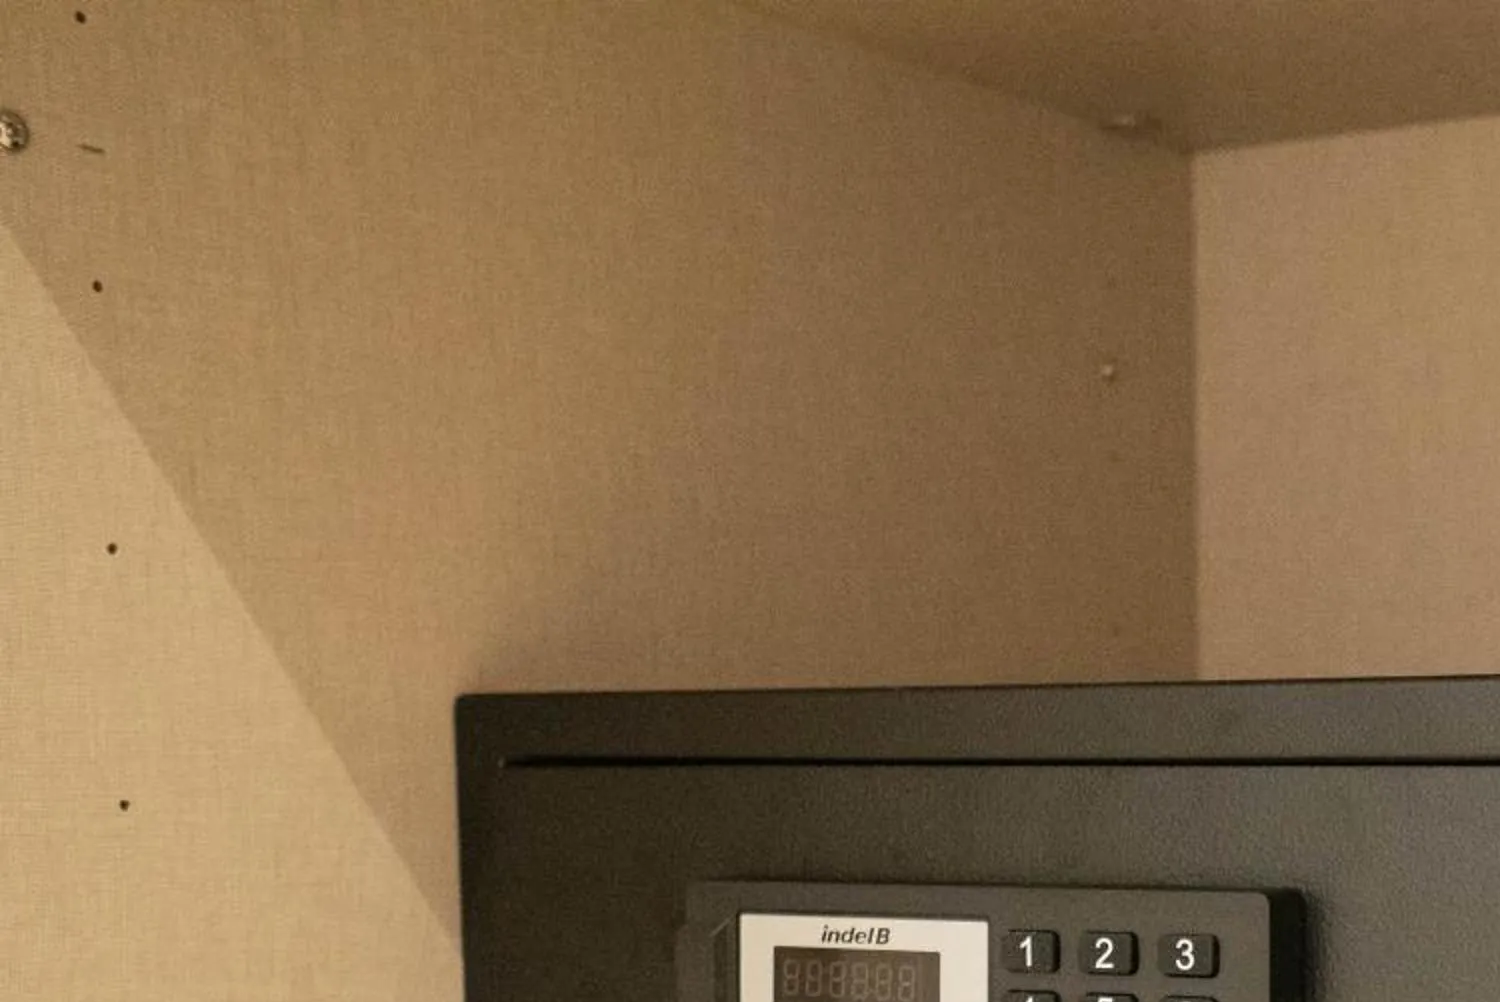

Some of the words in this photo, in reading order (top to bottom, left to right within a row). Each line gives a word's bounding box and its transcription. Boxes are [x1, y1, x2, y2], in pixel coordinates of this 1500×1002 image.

[1019, 936, 1033, 968] 1
[1095, 937, 1114, 969] 2
[1175, 938, 1195, 971] 3
